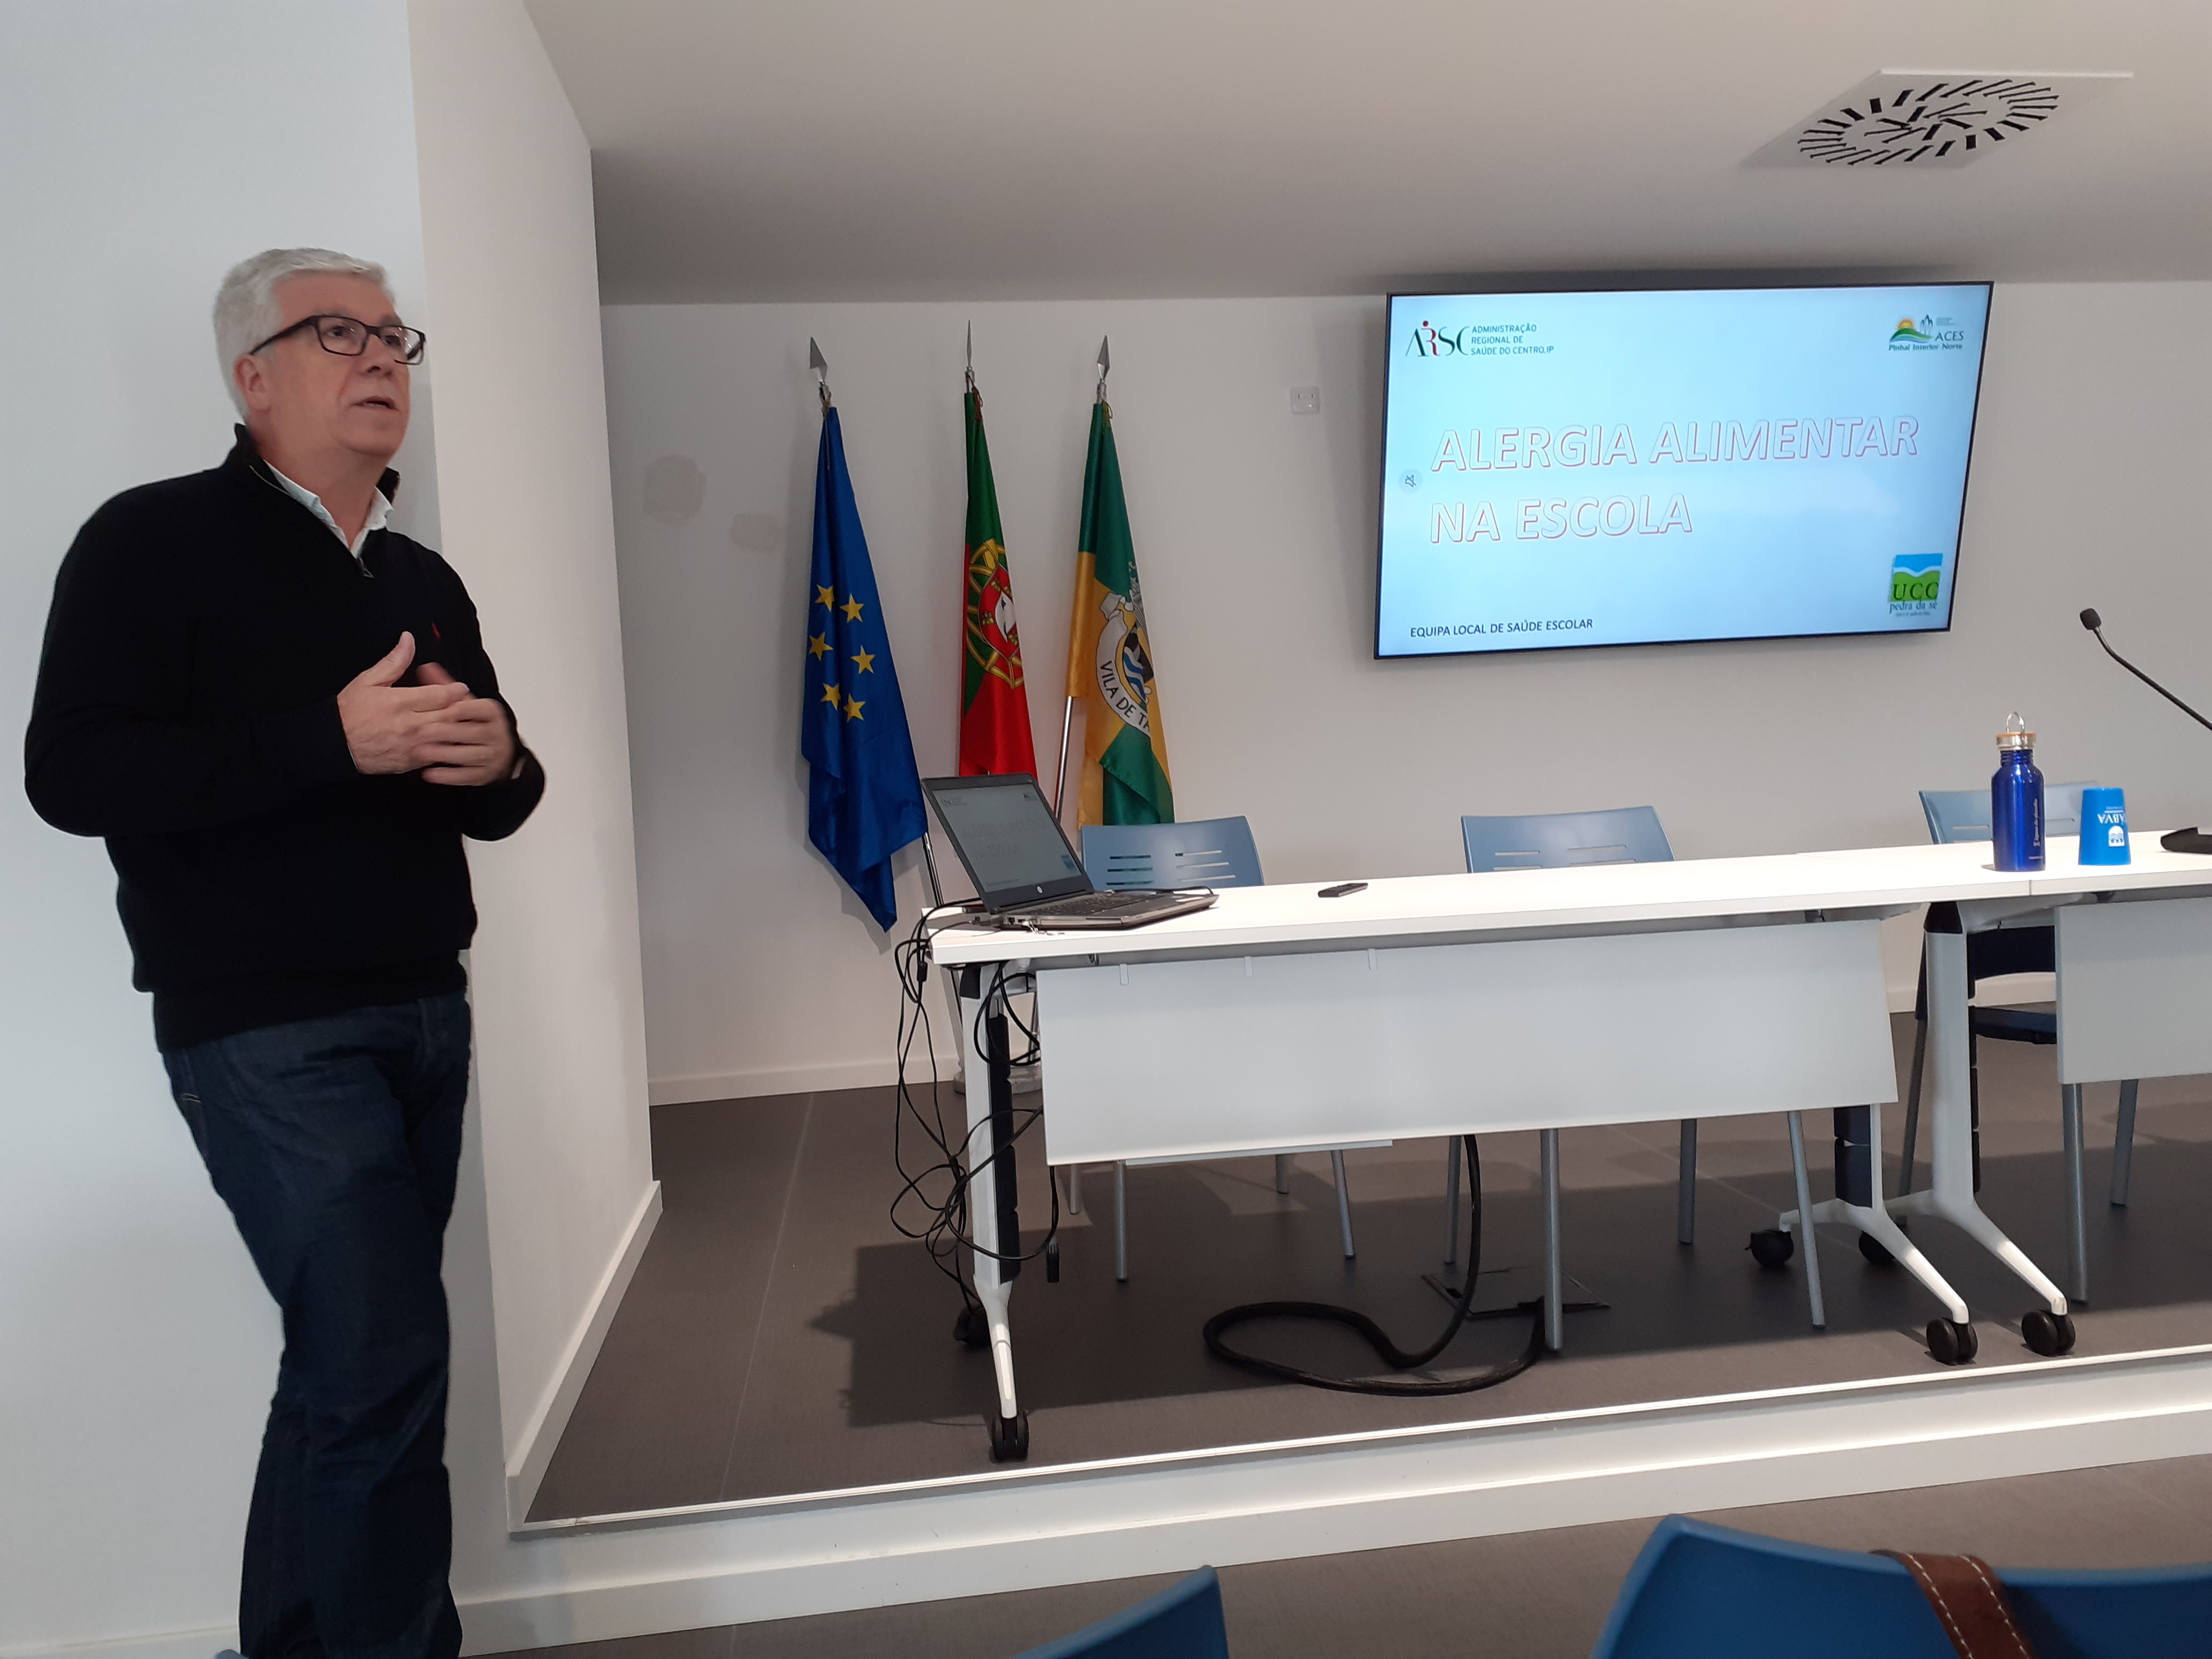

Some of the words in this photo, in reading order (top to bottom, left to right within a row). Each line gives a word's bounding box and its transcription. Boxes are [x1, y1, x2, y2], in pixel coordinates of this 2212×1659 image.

[1472, 323, 1537, 334] ADMINISTRAÇÃO
[1935, 331, 1964, 342] ACES
[1471, 335, 1511, 344] REGIONAL
[1513, 335, 1523, 343] DE
[1471, 346, 1497, 355] SAÚDE
[1499, 346, 1511, 355] DO
[1431, 423, 1638, 472] ALERGIA
[1648, 416, 1918, 464] ALIMENTAR
[1431, 501, 1501, 543] NA
[1515, 493, 1693, 540] ESCOLA
[1893, 581, 1939, 600] UCC
[1916, 595, 1926, 610] da
[1410, 626, 1451, 638] EQUIPA
[1453, 624, 1486, 636] LOCAL
[1490, 623, 1504, 633] DE
[1507, 619, 1543, 632] SAÚDE
[1546, 618, 1593, 631] ESCOLAR
[1100, 660, 1119, 699] VILA
[1115, 696, 1137, 718] DE
